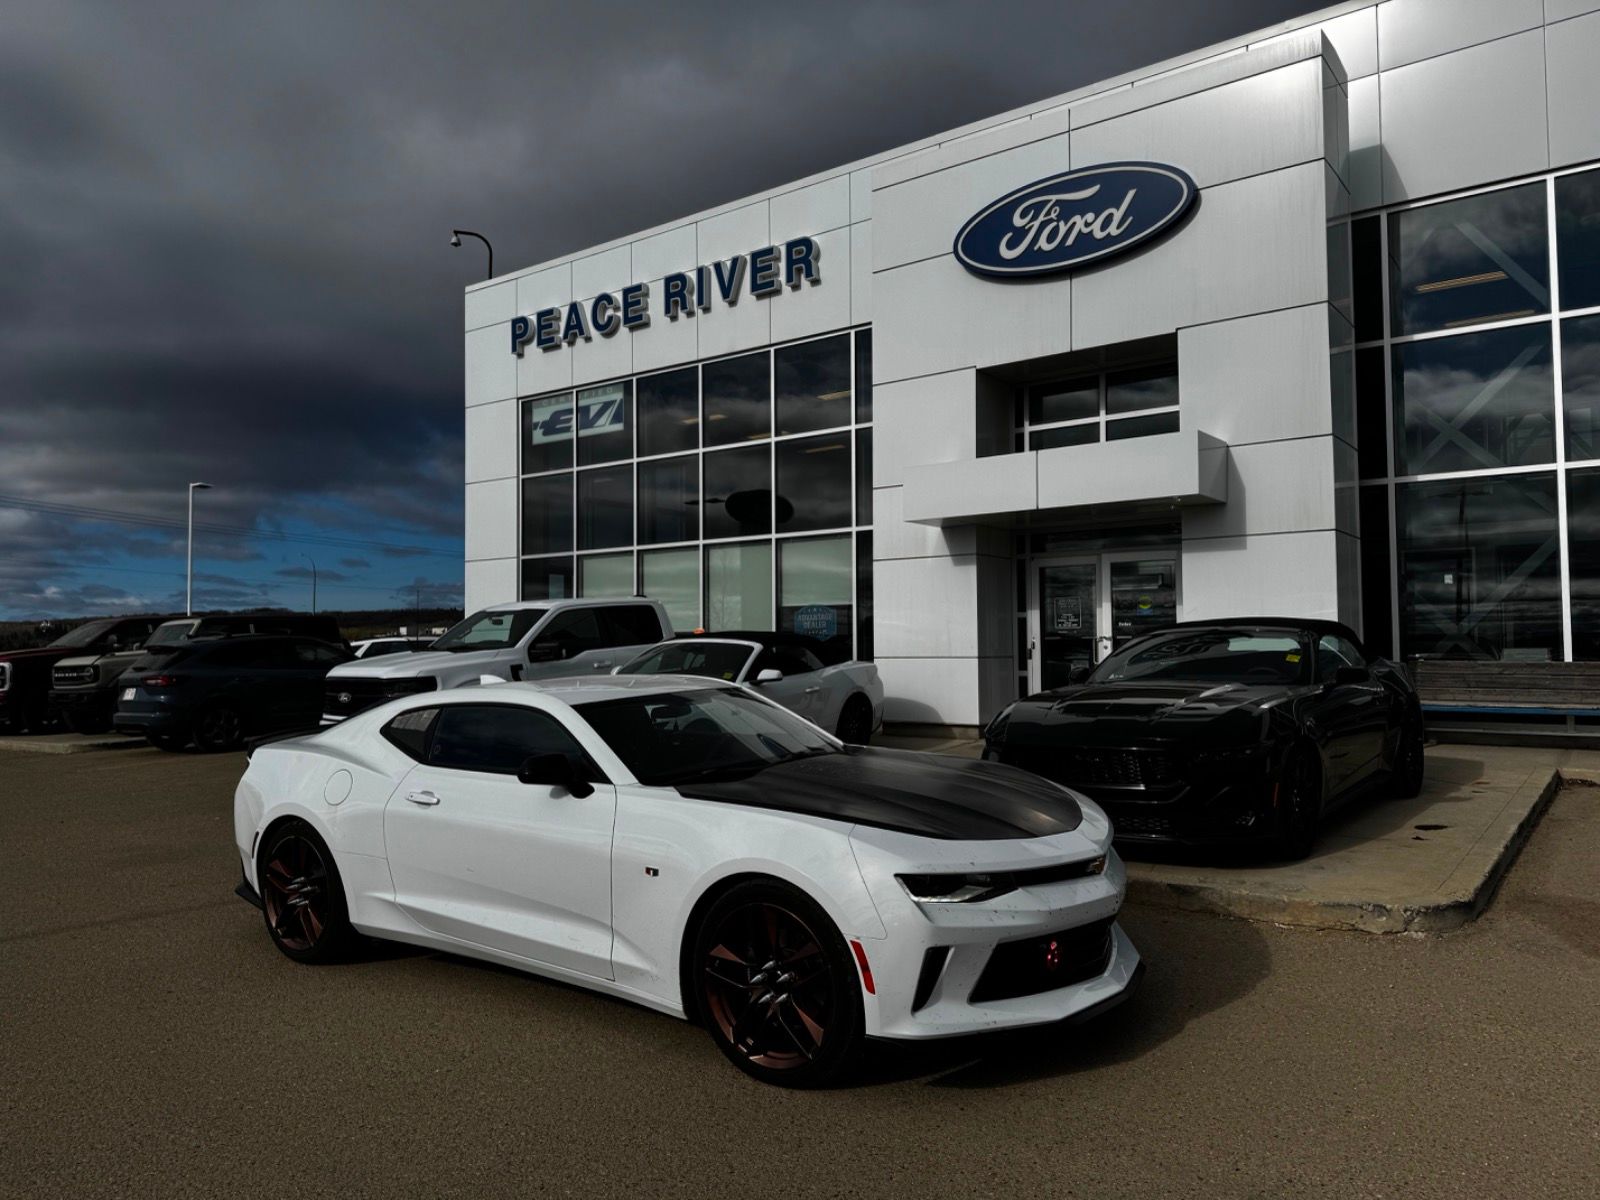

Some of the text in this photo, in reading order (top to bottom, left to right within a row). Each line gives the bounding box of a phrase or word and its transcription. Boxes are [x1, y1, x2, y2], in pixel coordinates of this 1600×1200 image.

[999, 184, 1137, 260] Ford
[511, 236, 821, 357] PEACE RIVER
